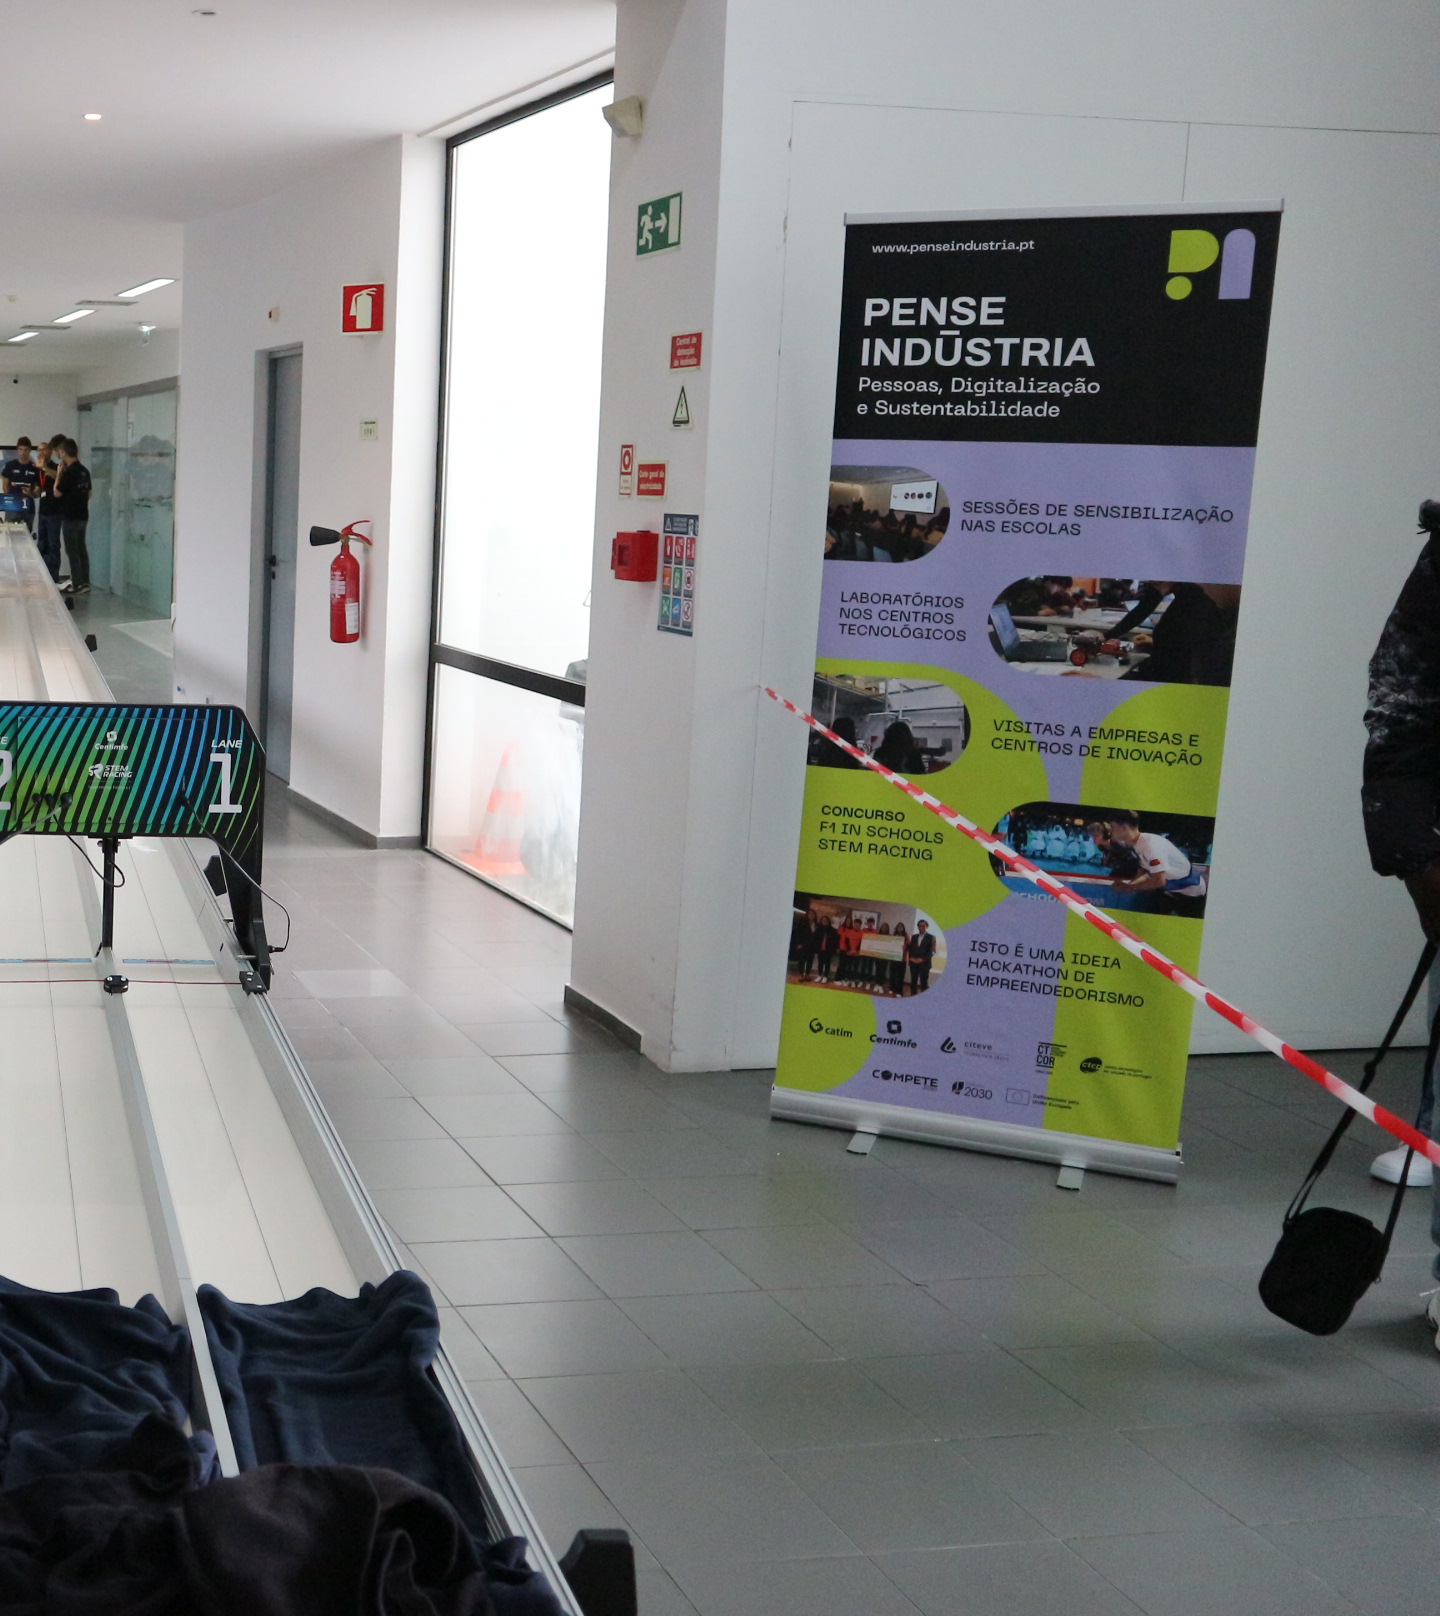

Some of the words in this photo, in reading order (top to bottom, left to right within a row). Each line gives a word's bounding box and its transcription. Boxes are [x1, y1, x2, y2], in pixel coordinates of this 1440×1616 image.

[872, 239, 1035, 254] www.penseindustria.pt
[864, 296, 1006, 326] PENSE
[859, 377, 943, 395] Pessoas,
[950, 377, 1100, 397] Digitalização
[857, 402, 868, 415] e
[875, 399, 1060, 418] Sustentabilidade
[22, 499, 28, 509] 1
[962, 499, 1039, 516] SESSÕES
[1046, 504, 1067, 517] DE
[1074, 504, 1234, 525] SENSIBILIZAÇÃO
[961, 520, 996, 533] NAS
[1000, 521, 1081, 536] ESCOLAS
[840, 591, 965, 609] LABORATÓRIOS
[839, 607, 872, 620] NOS
[877, 609, 955, 625] CENTROS
[839, 622, 967, 642] TECNOLÓGICOS
[993, 719, 1066, 737] VISITAS
[1070, 726, 1082, 738] A
[1087, 727, 1182, 746] EMPRESAS
[1189, 733, 1199, 746] E
[211, 740, 243, 748] LANE
[991, 737, 1073, 756] CENTROS
[1078, 743, 1102, 758] DE
[1106, 745, 1203, 767] INOVAÇÃO
[209, 753, 242, 813] 1
[821, 805, 906, 823] CONCURSO
[820, 821, 836, 834] F1
[841, 822, 861, 836] IN
[865, 825, 944, 845] SCHOOLS
[818, 838, 863, 854] STEM
[867, 842, 934, 862] RACING
[969, 940, 1010, 956] ISTO
[1014, 942, 1025, 958] É
[1028, 947, 1066, 963] UMA
[1071, 952, 1122, 970] IDEIA
[967, 958, 1069, 981] HACKATHON
[1073, 970, 1095, 984] DE
[965, 974, 1145, 1008] EMPREENDEDORISMO
[825, 1026, 852, 1038] catim
[870, 1034, 917, 1048] Centimfe
[964, 1041, 992, 1050] citeve
[1038, 1045, 1050, 1055] CT
[1037, 1055, 1055, 1066] COR
[872, 1070, 938, 1088] COMPETE
[964, 1087, 992, 1100] 2030
